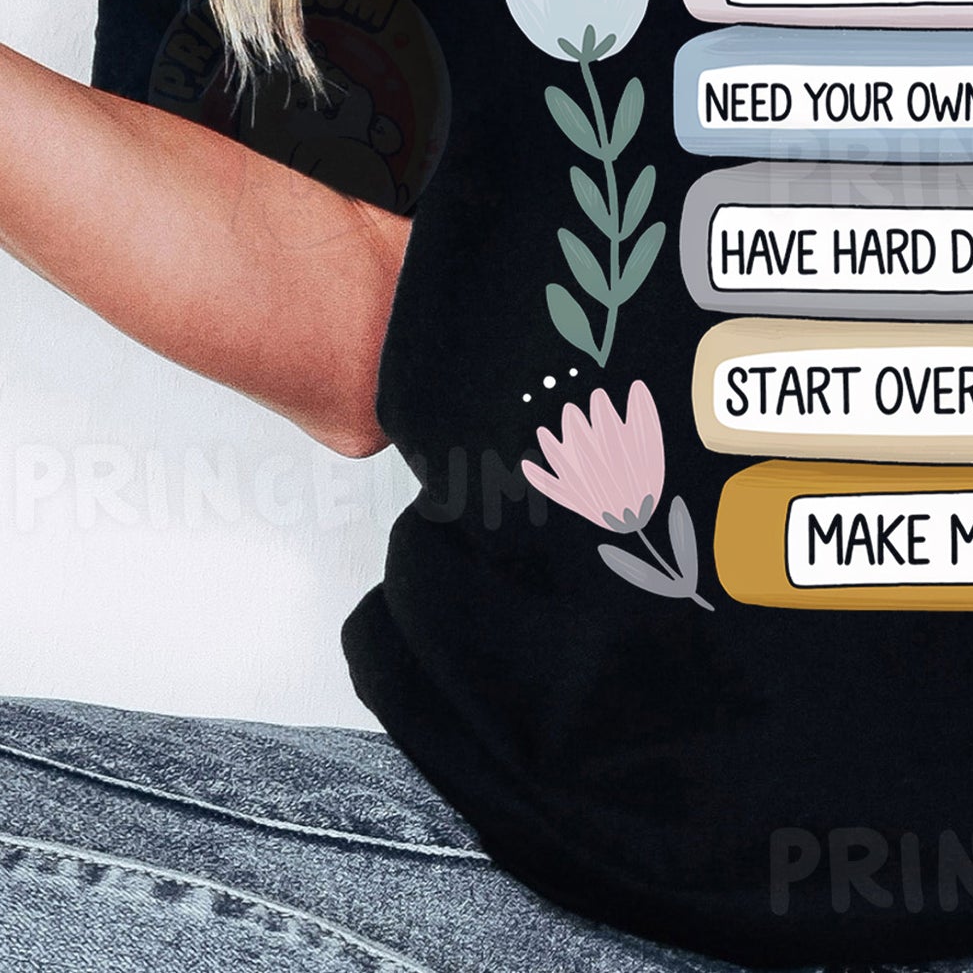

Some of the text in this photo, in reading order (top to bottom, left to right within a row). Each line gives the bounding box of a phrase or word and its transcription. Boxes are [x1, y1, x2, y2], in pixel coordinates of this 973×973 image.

[705, 82, 792, 123] NEED
[803, 81, 893, 122] YOUR
[721, 229, 818, 276] HAVE
[833, 228, 936, 275] HARD
[726, 366, 862, 417] START
[808, 513, 931, 566] MAKE
